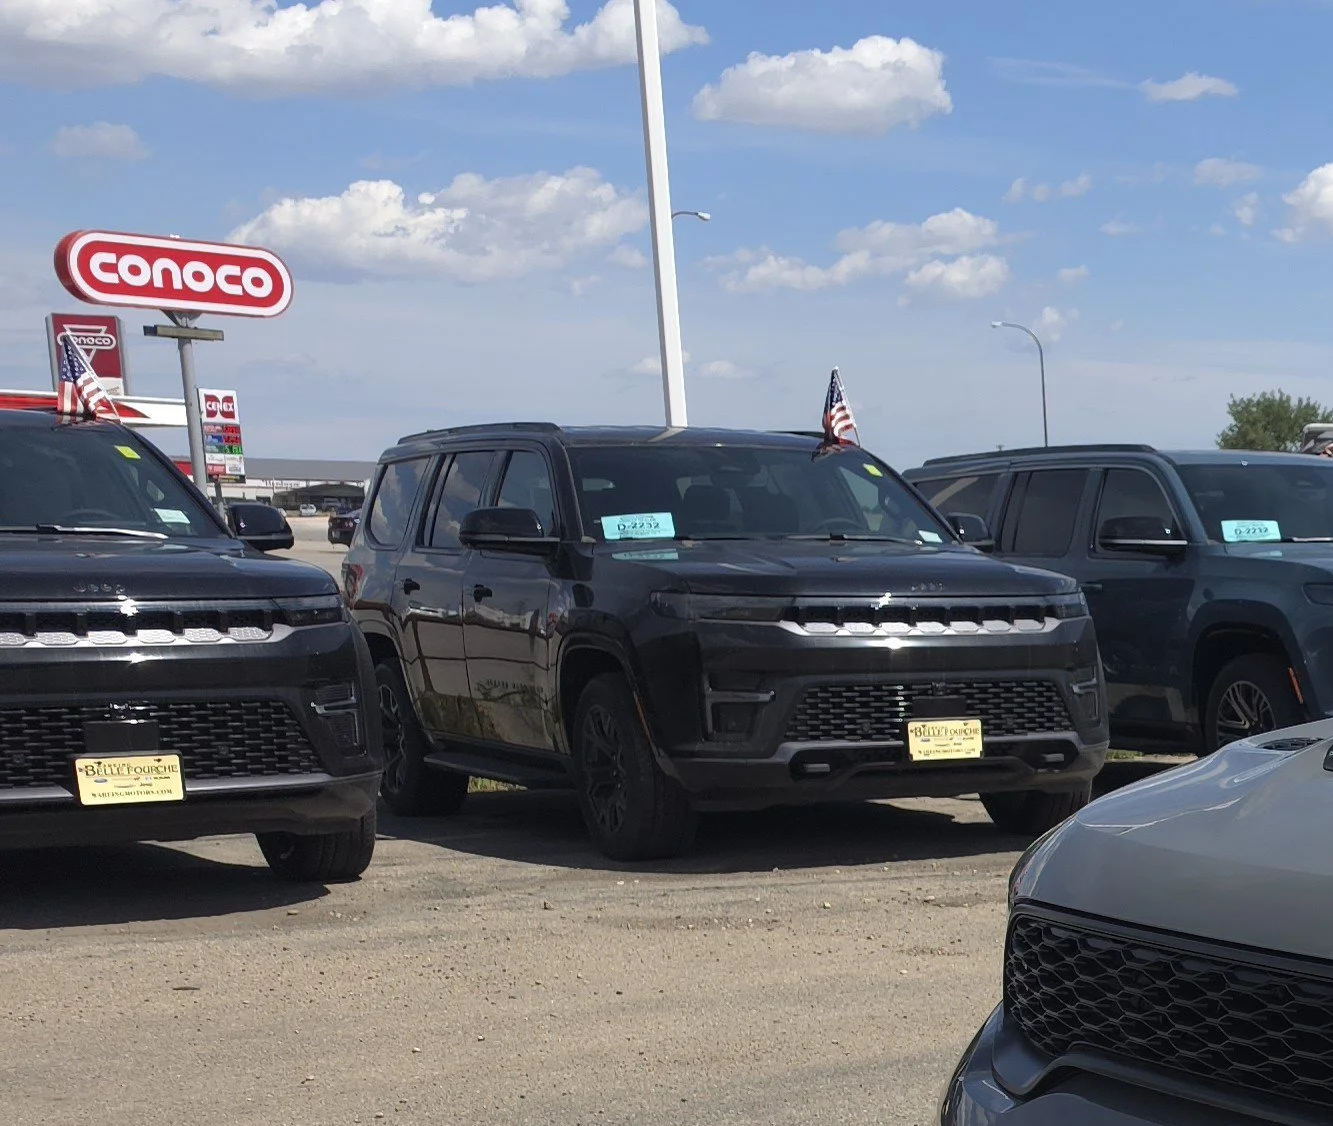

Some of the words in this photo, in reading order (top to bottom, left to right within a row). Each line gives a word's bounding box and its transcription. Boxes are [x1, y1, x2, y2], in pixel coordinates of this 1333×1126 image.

[206, 401, 235, 413] CENEX
[85, 765, 125, 777] BELLE
[126, 764, 179, 776] FOURCHE
